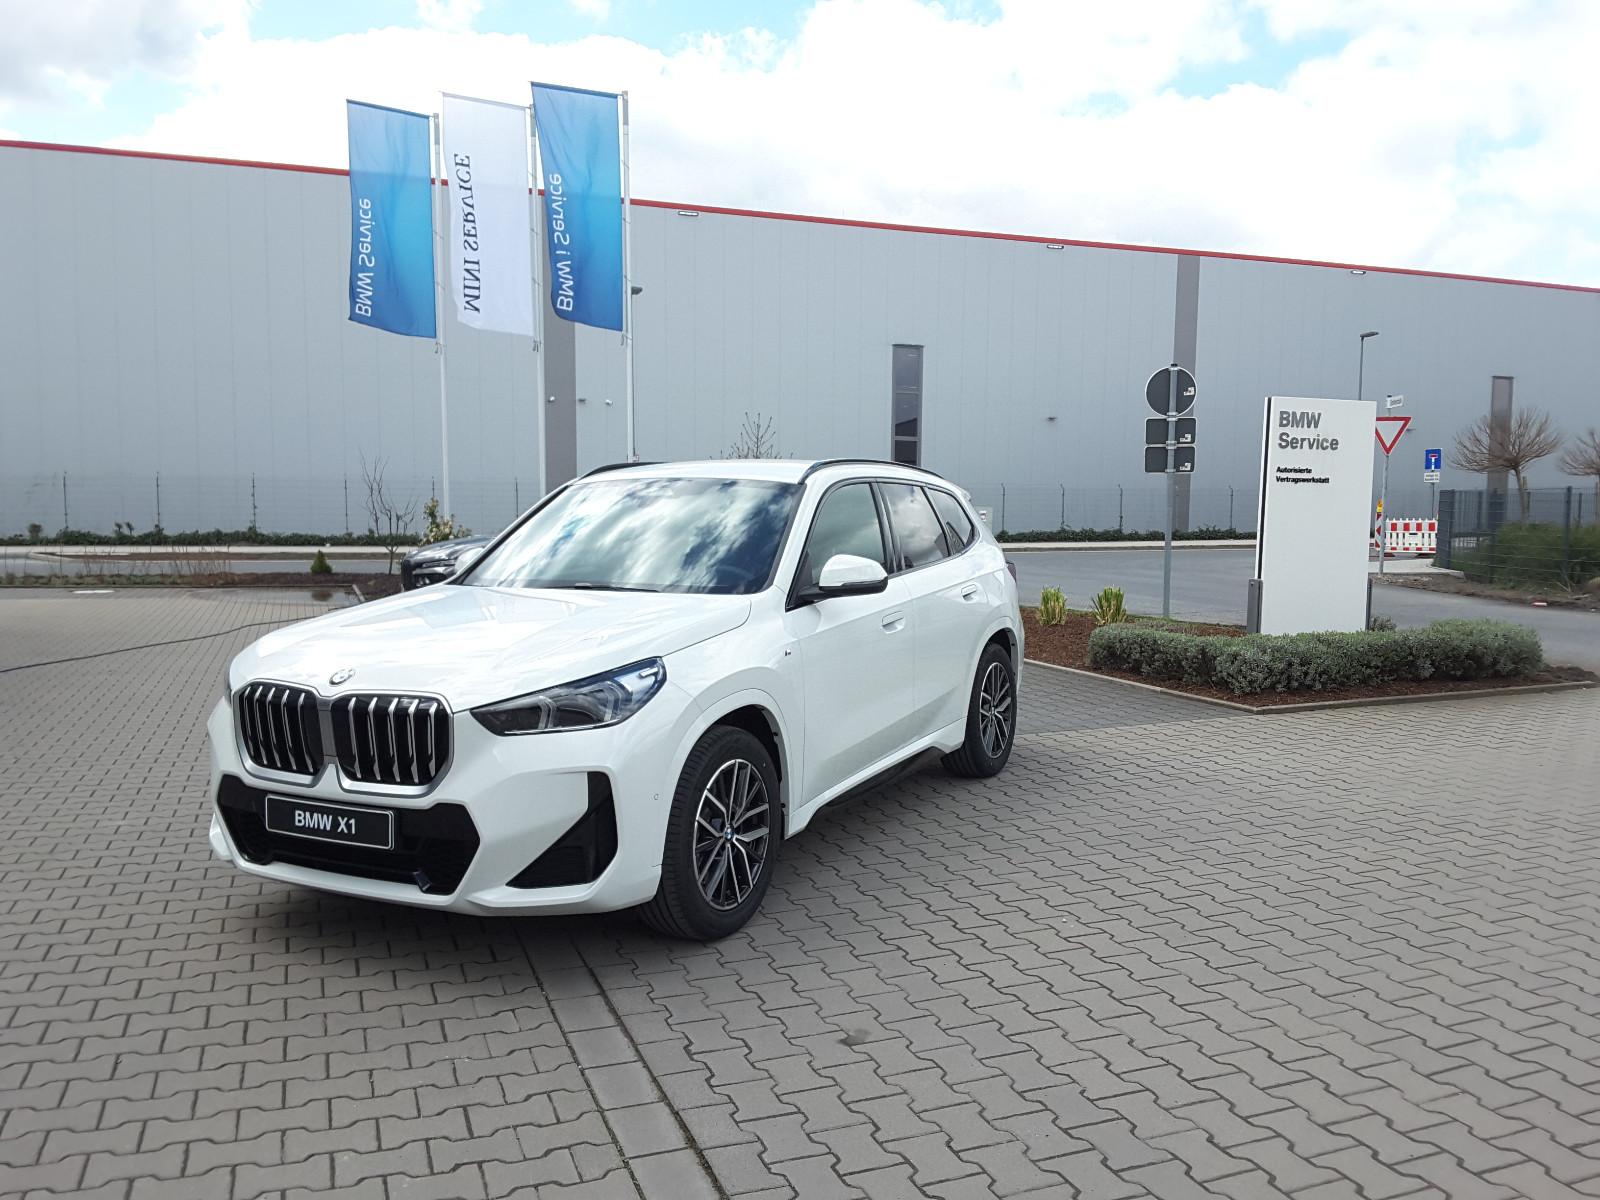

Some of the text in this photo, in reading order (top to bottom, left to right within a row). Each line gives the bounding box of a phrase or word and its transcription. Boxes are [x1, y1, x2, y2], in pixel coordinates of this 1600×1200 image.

[1279, 411, 1321, 428] BMW
[1278, 432, 1339, 450] Service
[295, 810, 355, 834] BMW X1
